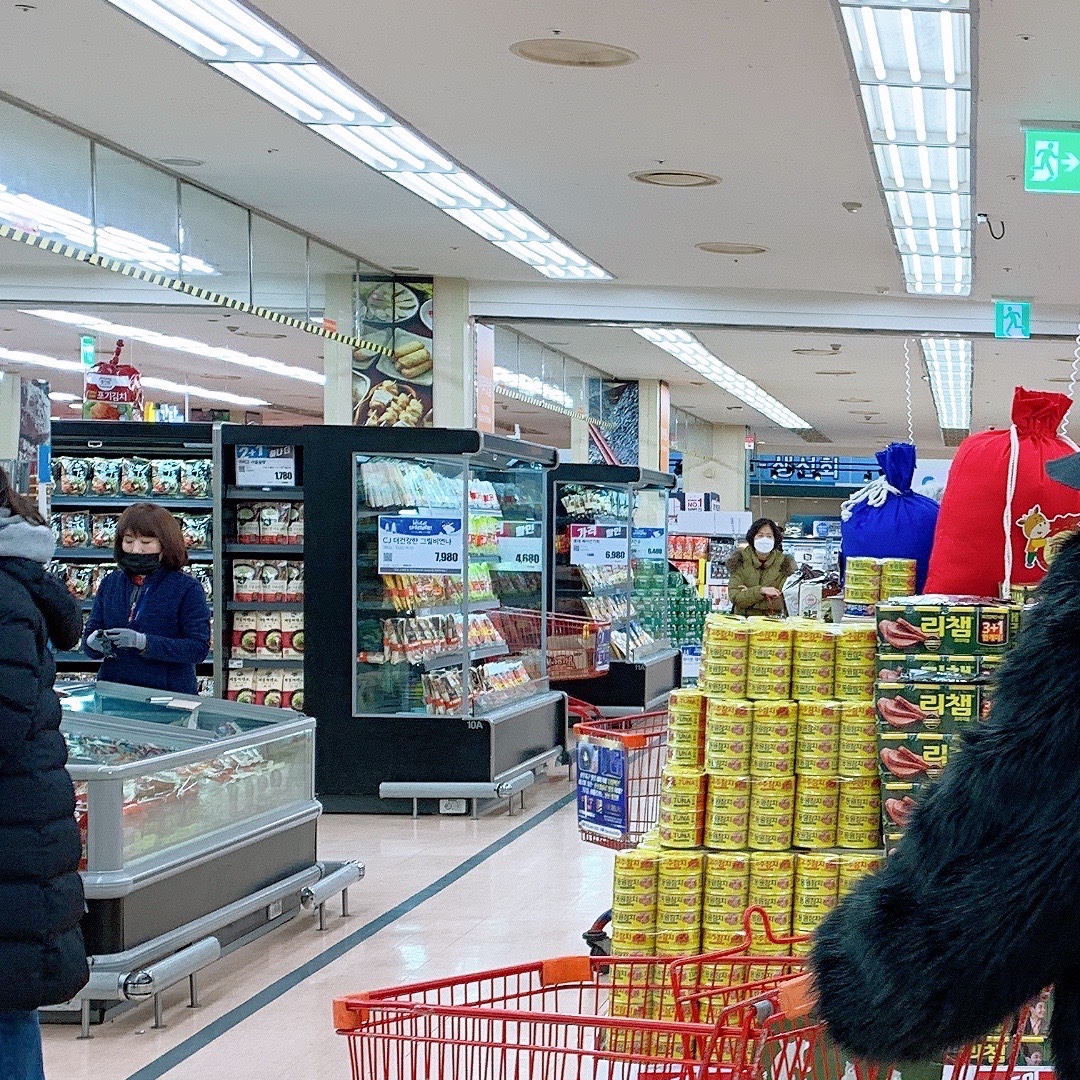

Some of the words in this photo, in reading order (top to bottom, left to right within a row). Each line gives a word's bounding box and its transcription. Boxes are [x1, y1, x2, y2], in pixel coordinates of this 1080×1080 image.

[96, 390, 128, 402] 포기김치
[238, 445, 265, 458] 2+1
[772, 455, 840, 480] 생선회
[274, 471, 293, 481] 1,780
[434, 551, 459, 562] 7,980
[515, 554, 540, 564] 4,680
[605, 550, 626, 560] 6,980
[921, 615, 973, 639] 리챔
[981, 620, 1004, 635] 3+1
[920, 693, 974, 717] 리챔
[673, 797, 691, 805] TUNA
[673, 814, 691, 822] TUNA
[673, 831, 691, 839] TUNA
